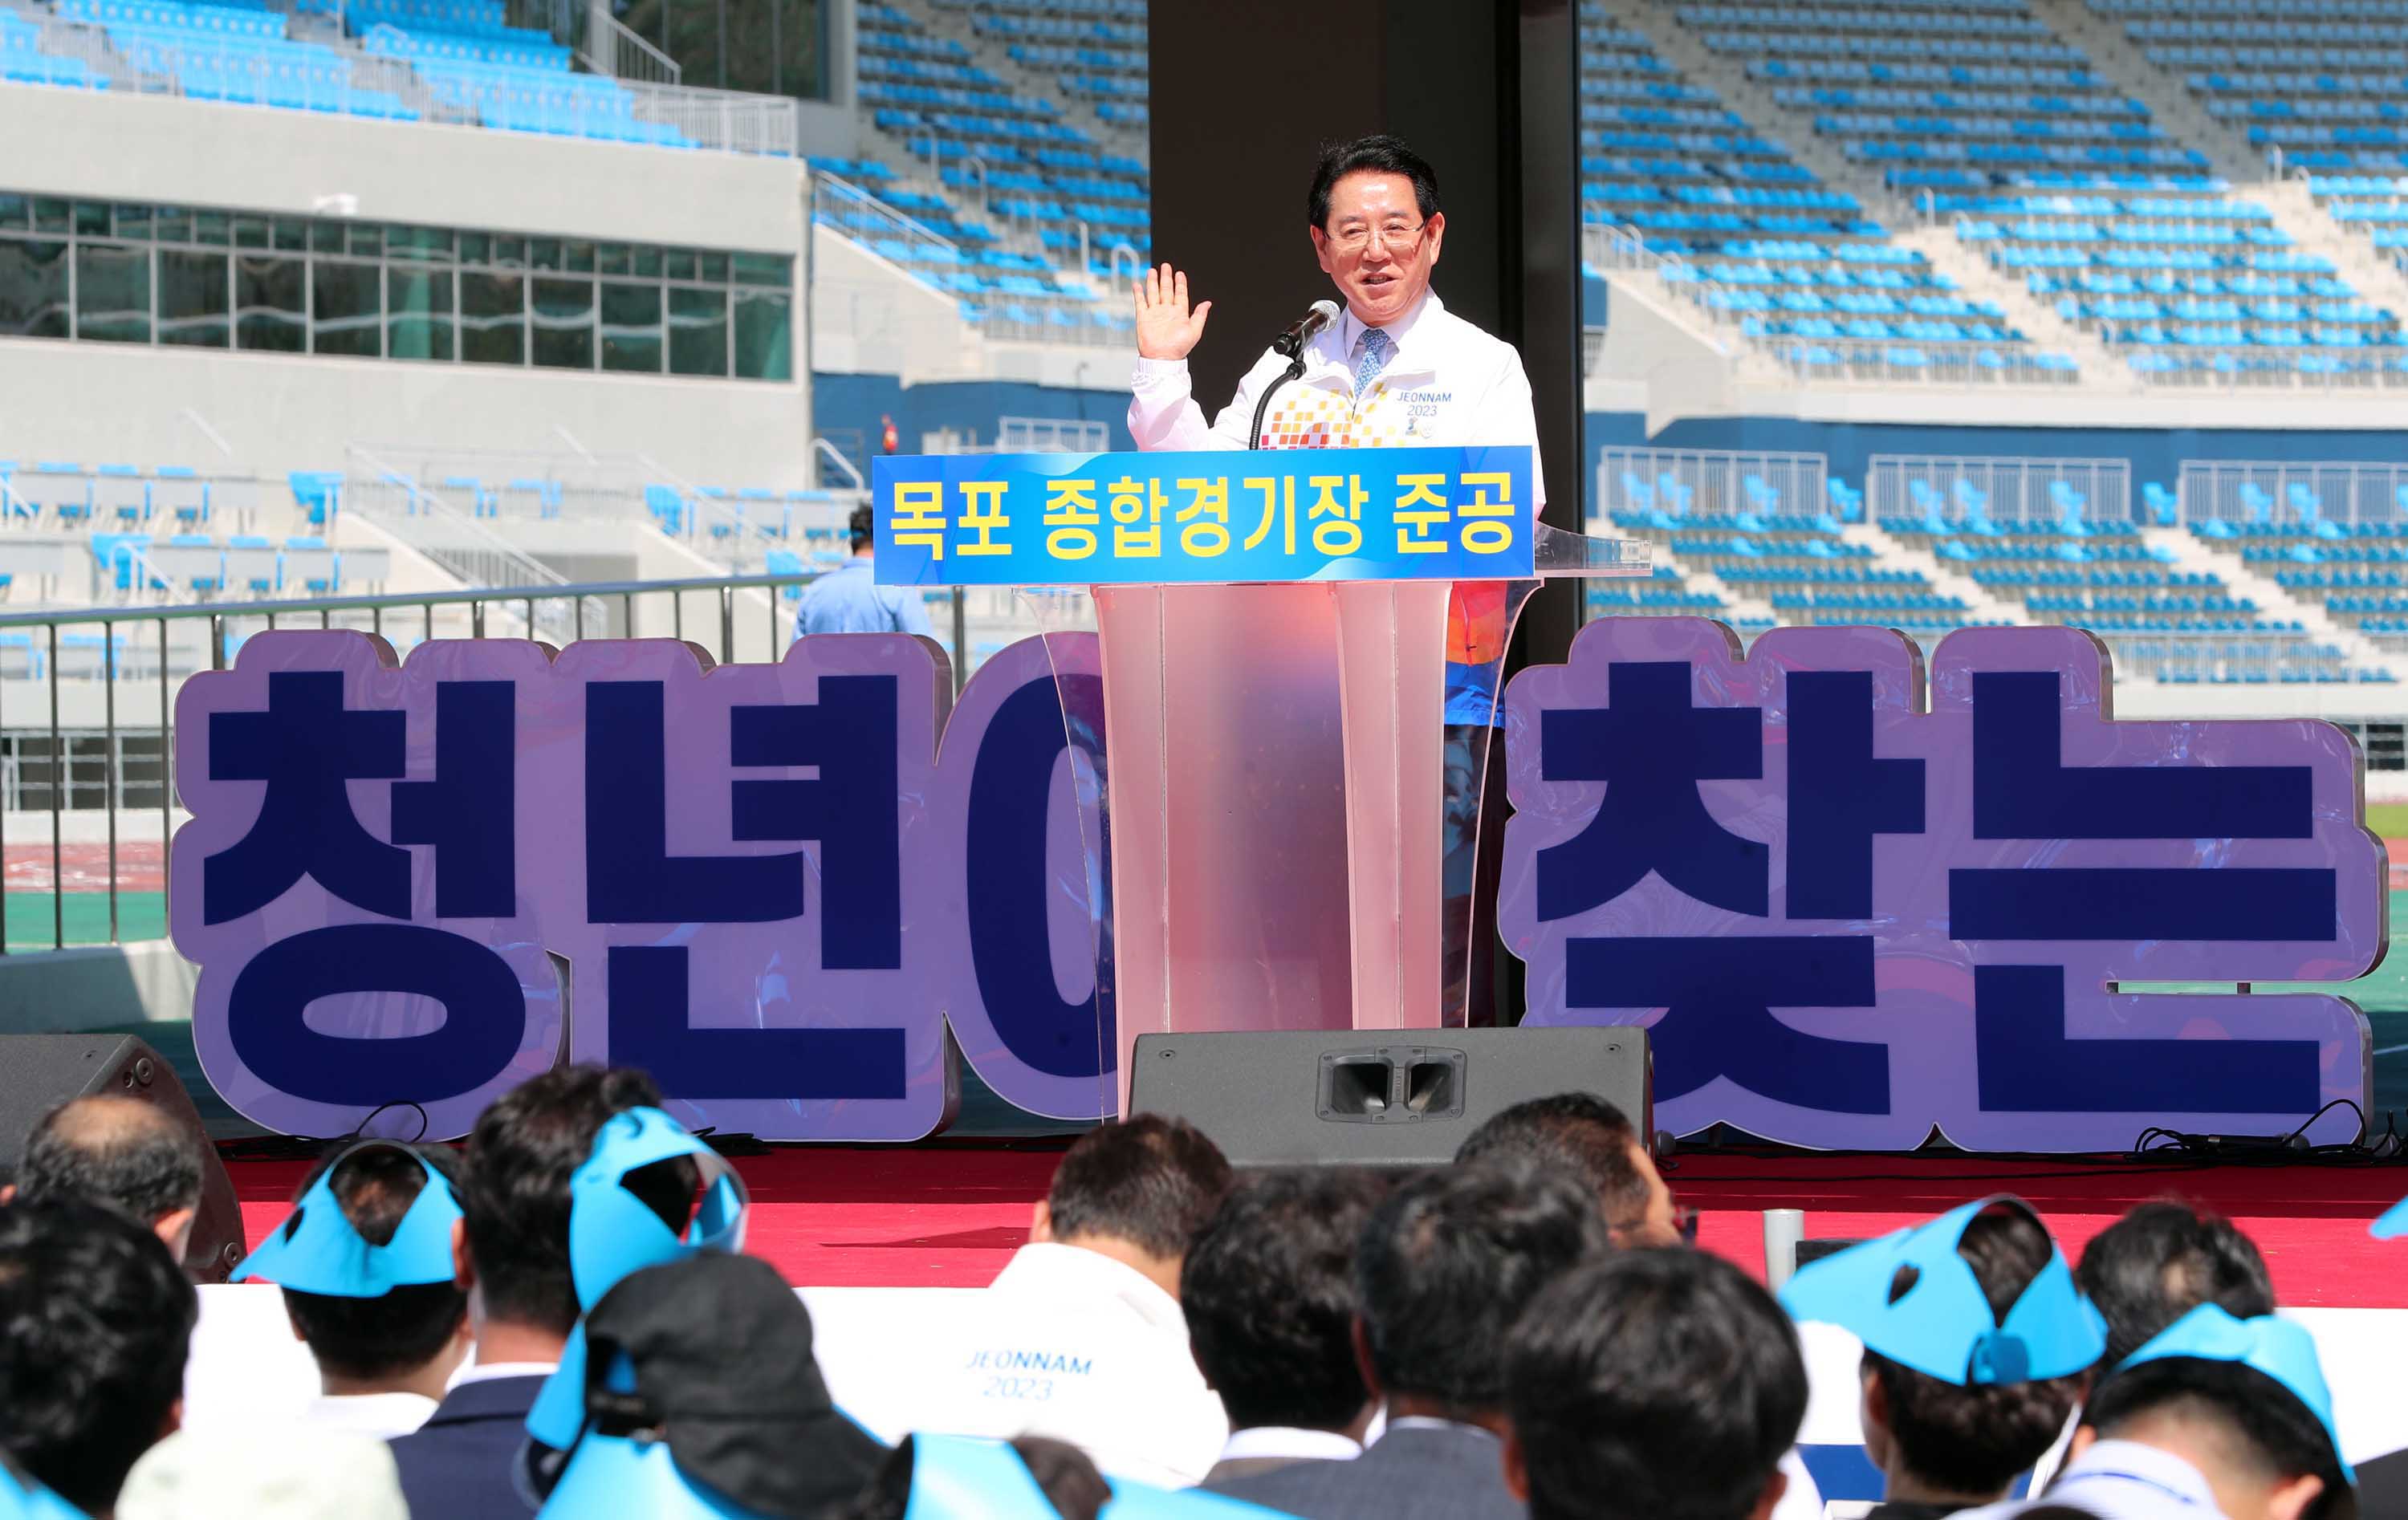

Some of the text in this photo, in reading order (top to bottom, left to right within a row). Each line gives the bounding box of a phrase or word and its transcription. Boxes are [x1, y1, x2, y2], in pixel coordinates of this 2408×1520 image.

[1397, 391, 1451, 403] JEONNAM
[1406, 404, 1438, 417] 2023
[891, 472, 1515, 560] 목포 종합경기장 준공
[1536, 661, 2337, 1115] 찾는
[966, 1348, 1092, 1375] JEONNAM
[982, 1375, 1053, 1400] 2023
